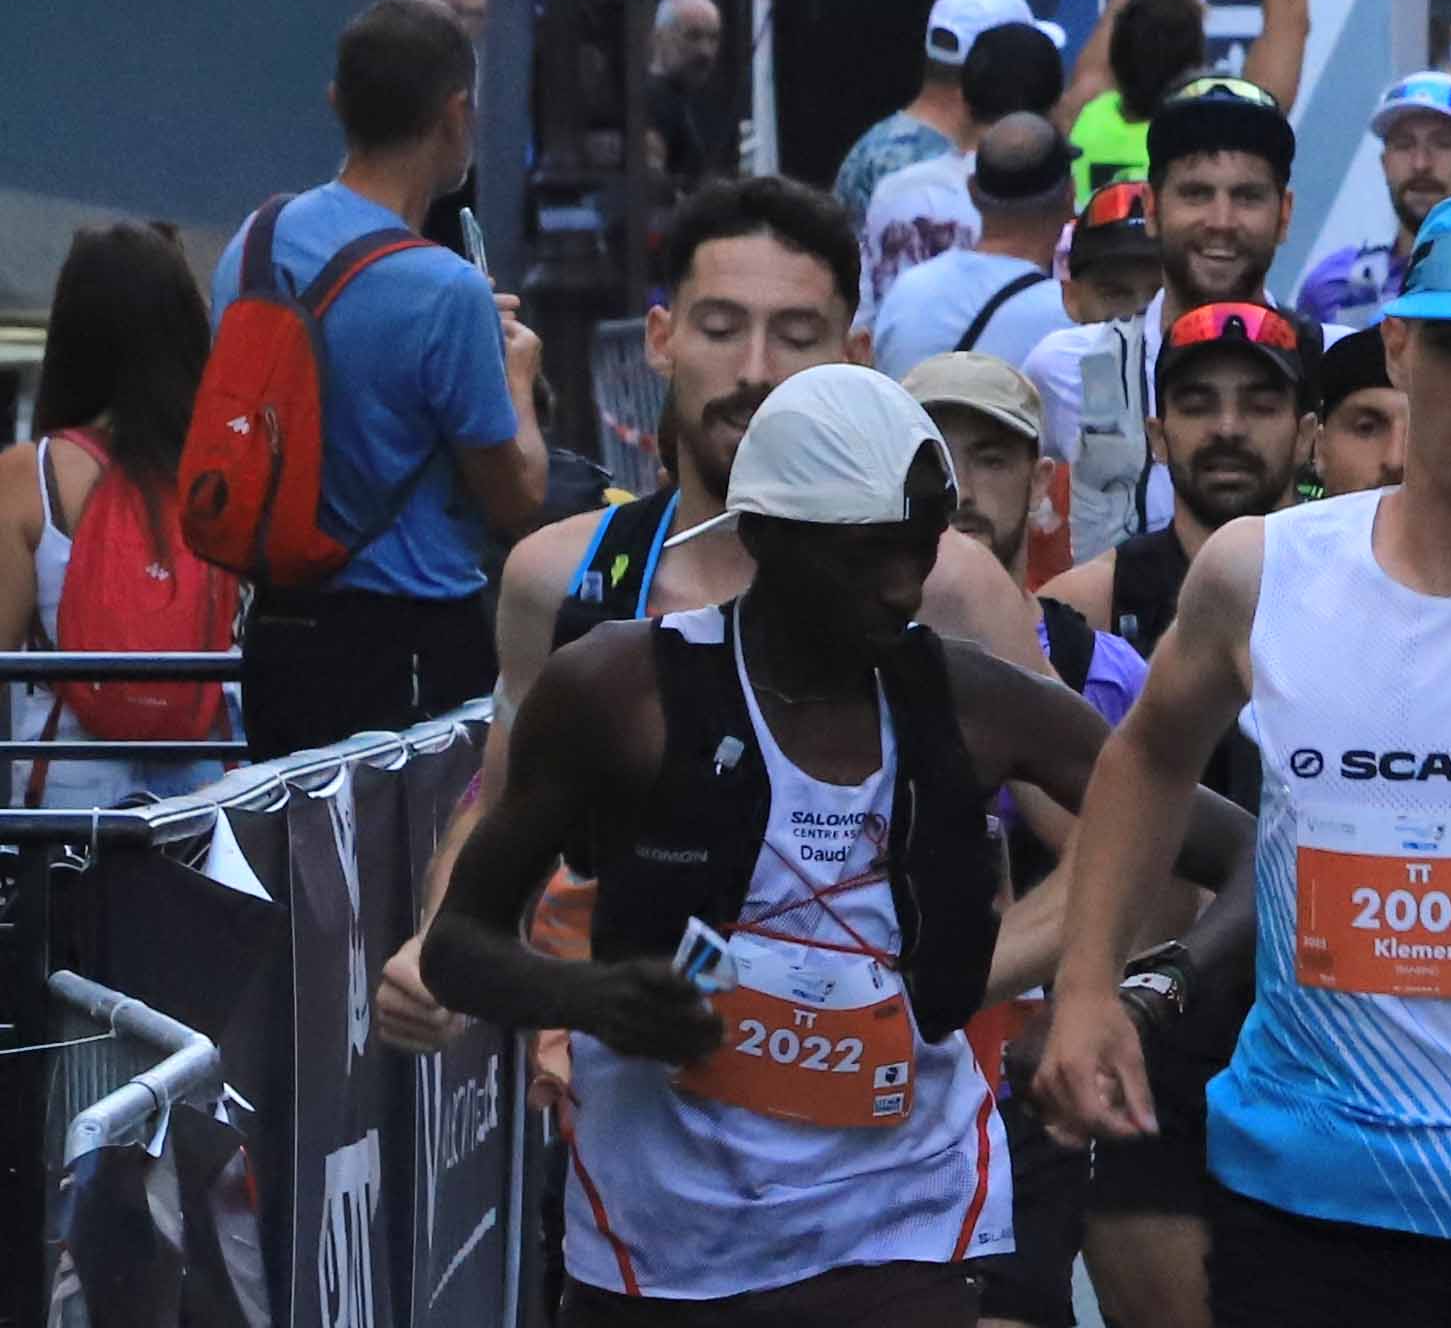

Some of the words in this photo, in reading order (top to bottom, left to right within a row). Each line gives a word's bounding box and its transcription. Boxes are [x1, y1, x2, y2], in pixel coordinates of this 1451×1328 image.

[1406, 862, 1433, 884] TT
[793, 1008, 818, 1029] TT
[736, 1018, 866, 1073] 2022
